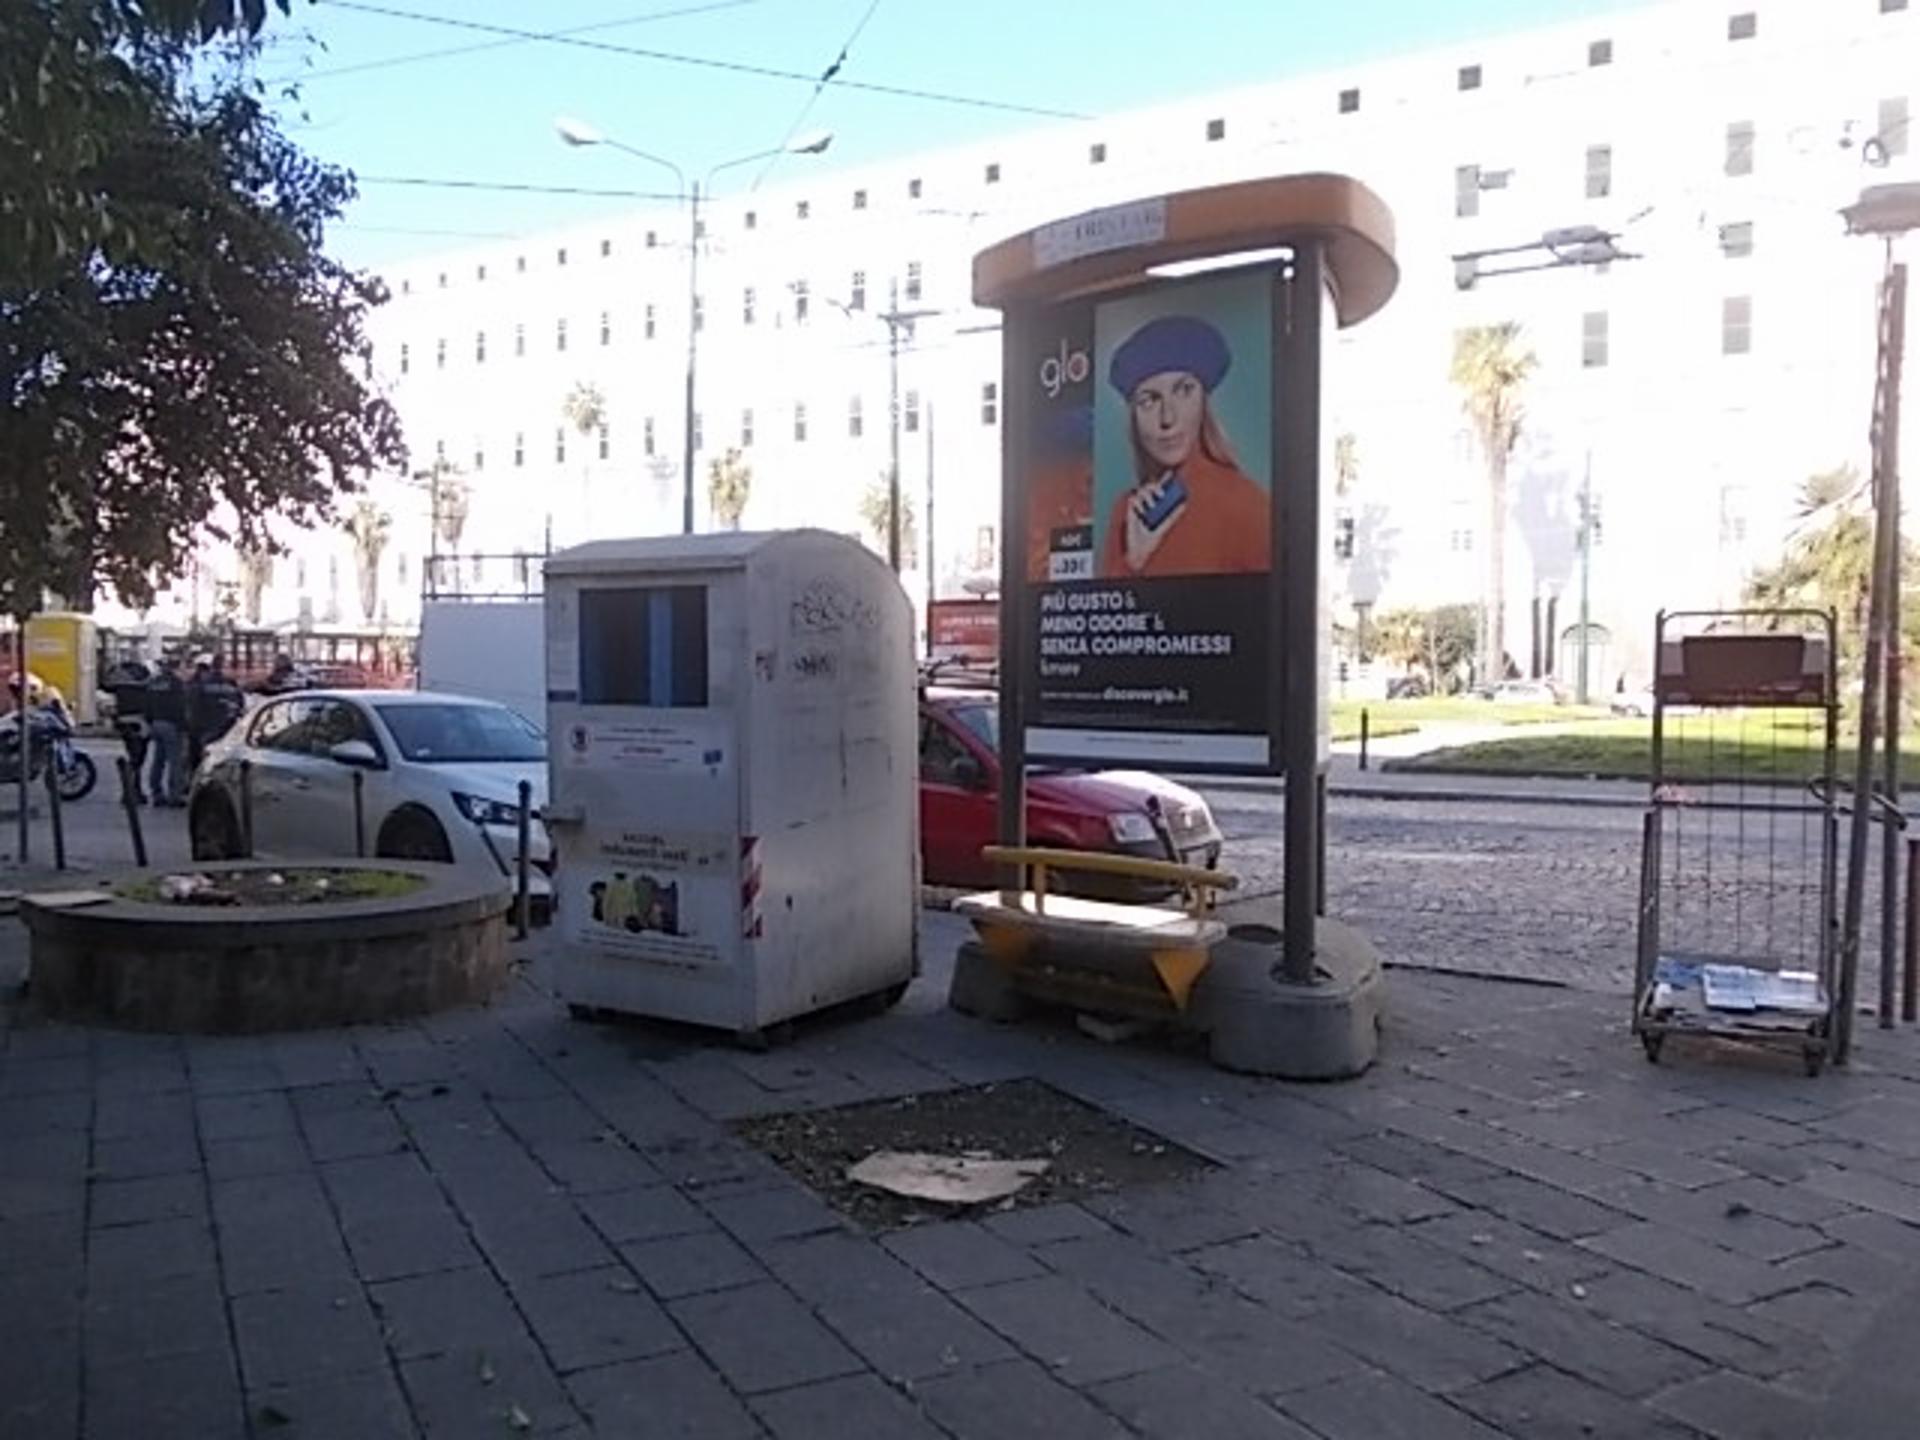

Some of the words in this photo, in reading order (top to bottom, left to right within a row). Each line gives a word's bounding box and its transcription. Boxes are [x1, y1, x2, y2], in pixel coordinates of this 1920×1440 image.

[1040, 338, 1089, 398] glo
[1068, 591, 1123, 610] GUSTO
[1041, 614, 1086, 633] MENO
[1040, 637, 1089, 655] SENZA
[1091, 635, 1231, 654] COMPROMESSI
